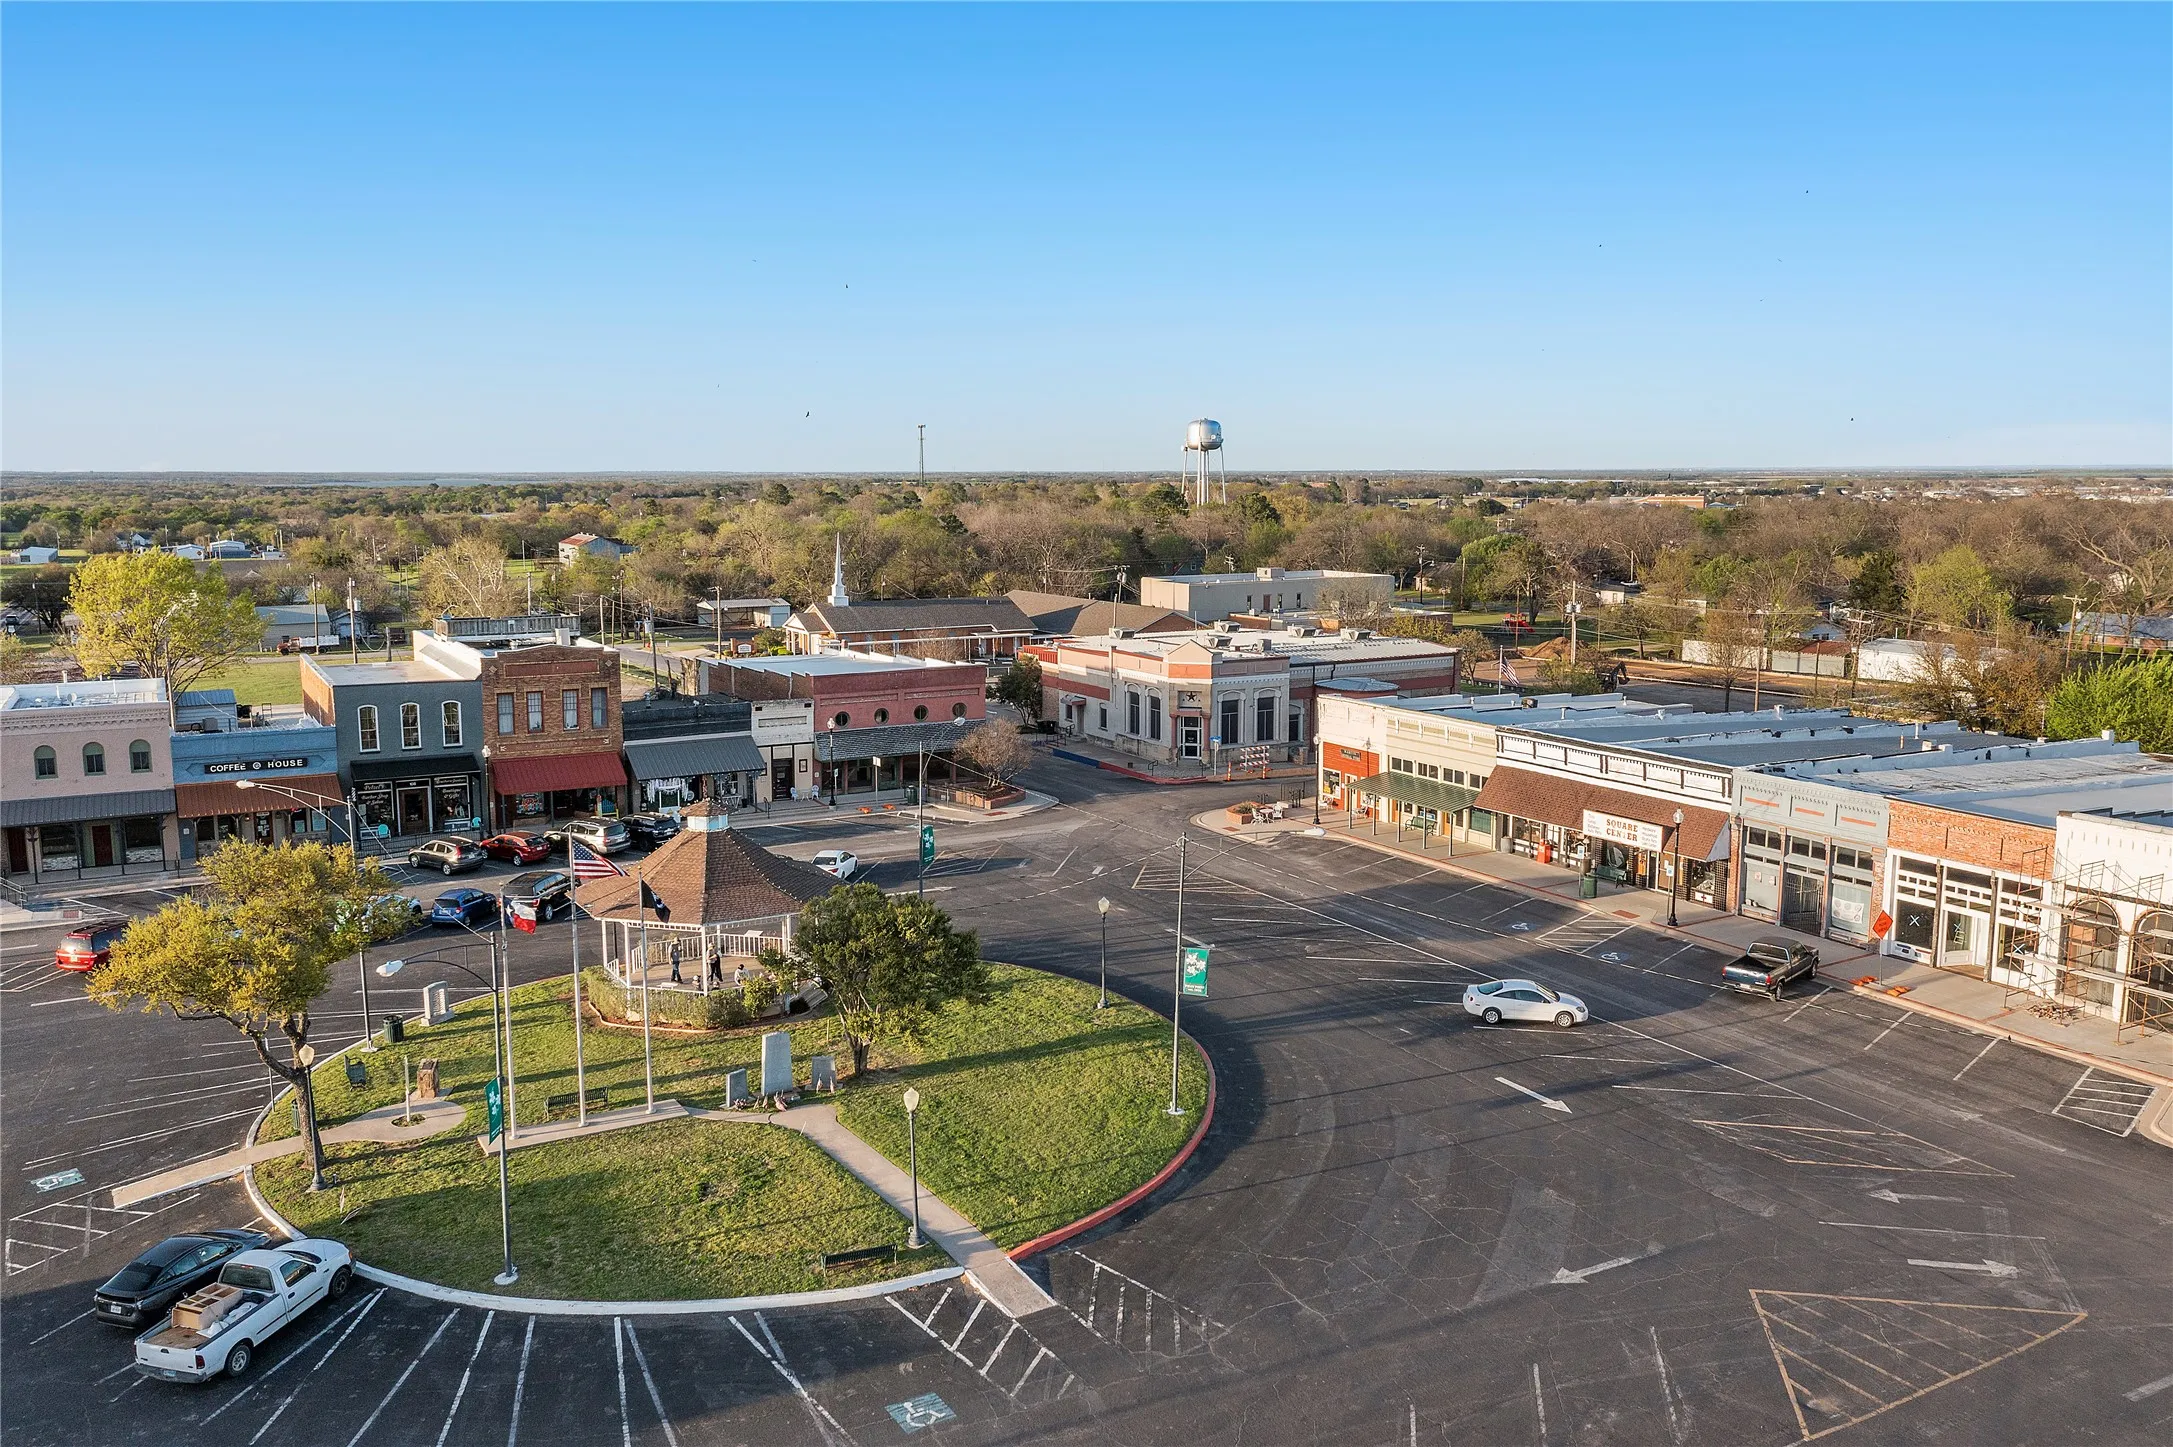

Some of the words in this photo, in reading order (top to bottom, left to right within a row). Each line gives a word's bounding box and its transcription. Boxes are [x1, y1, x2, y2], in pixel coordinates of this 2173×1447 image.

[210, 763, 247, 773] COFFEE
[267, 759, 304, 768] HOUSE
[1606, 819, 1638, 832] SQUARE
[1606, 828, 1638, 842] CENTER
